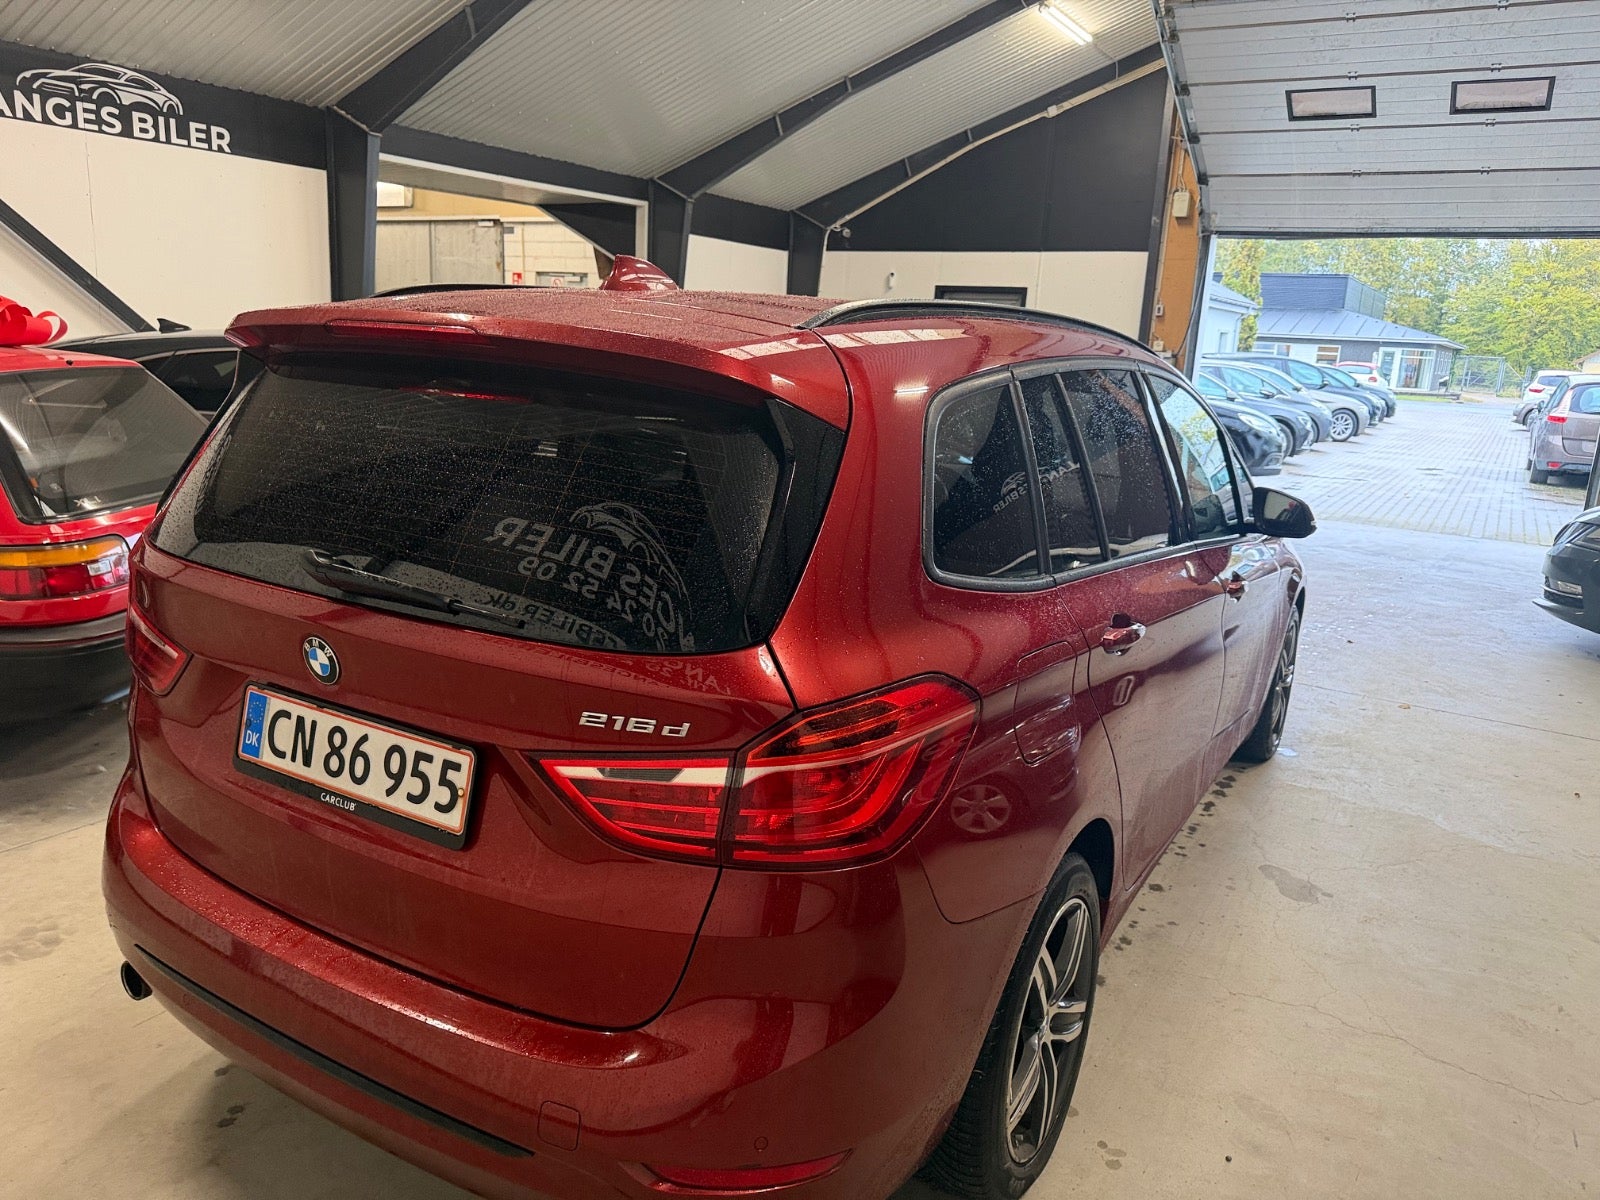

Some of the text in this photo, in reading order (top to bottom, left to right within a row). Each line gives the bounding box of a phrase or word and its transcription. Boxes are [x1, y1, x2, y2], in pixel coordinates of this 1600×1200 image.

[132, 110, 232, 153] BILER
[579, 711, 658, 734] 216
[245, 730, 259, 747] DK
[267, 709, 463, 814] CN 86 955
[320, 792, 356, 811] CARCLUB
